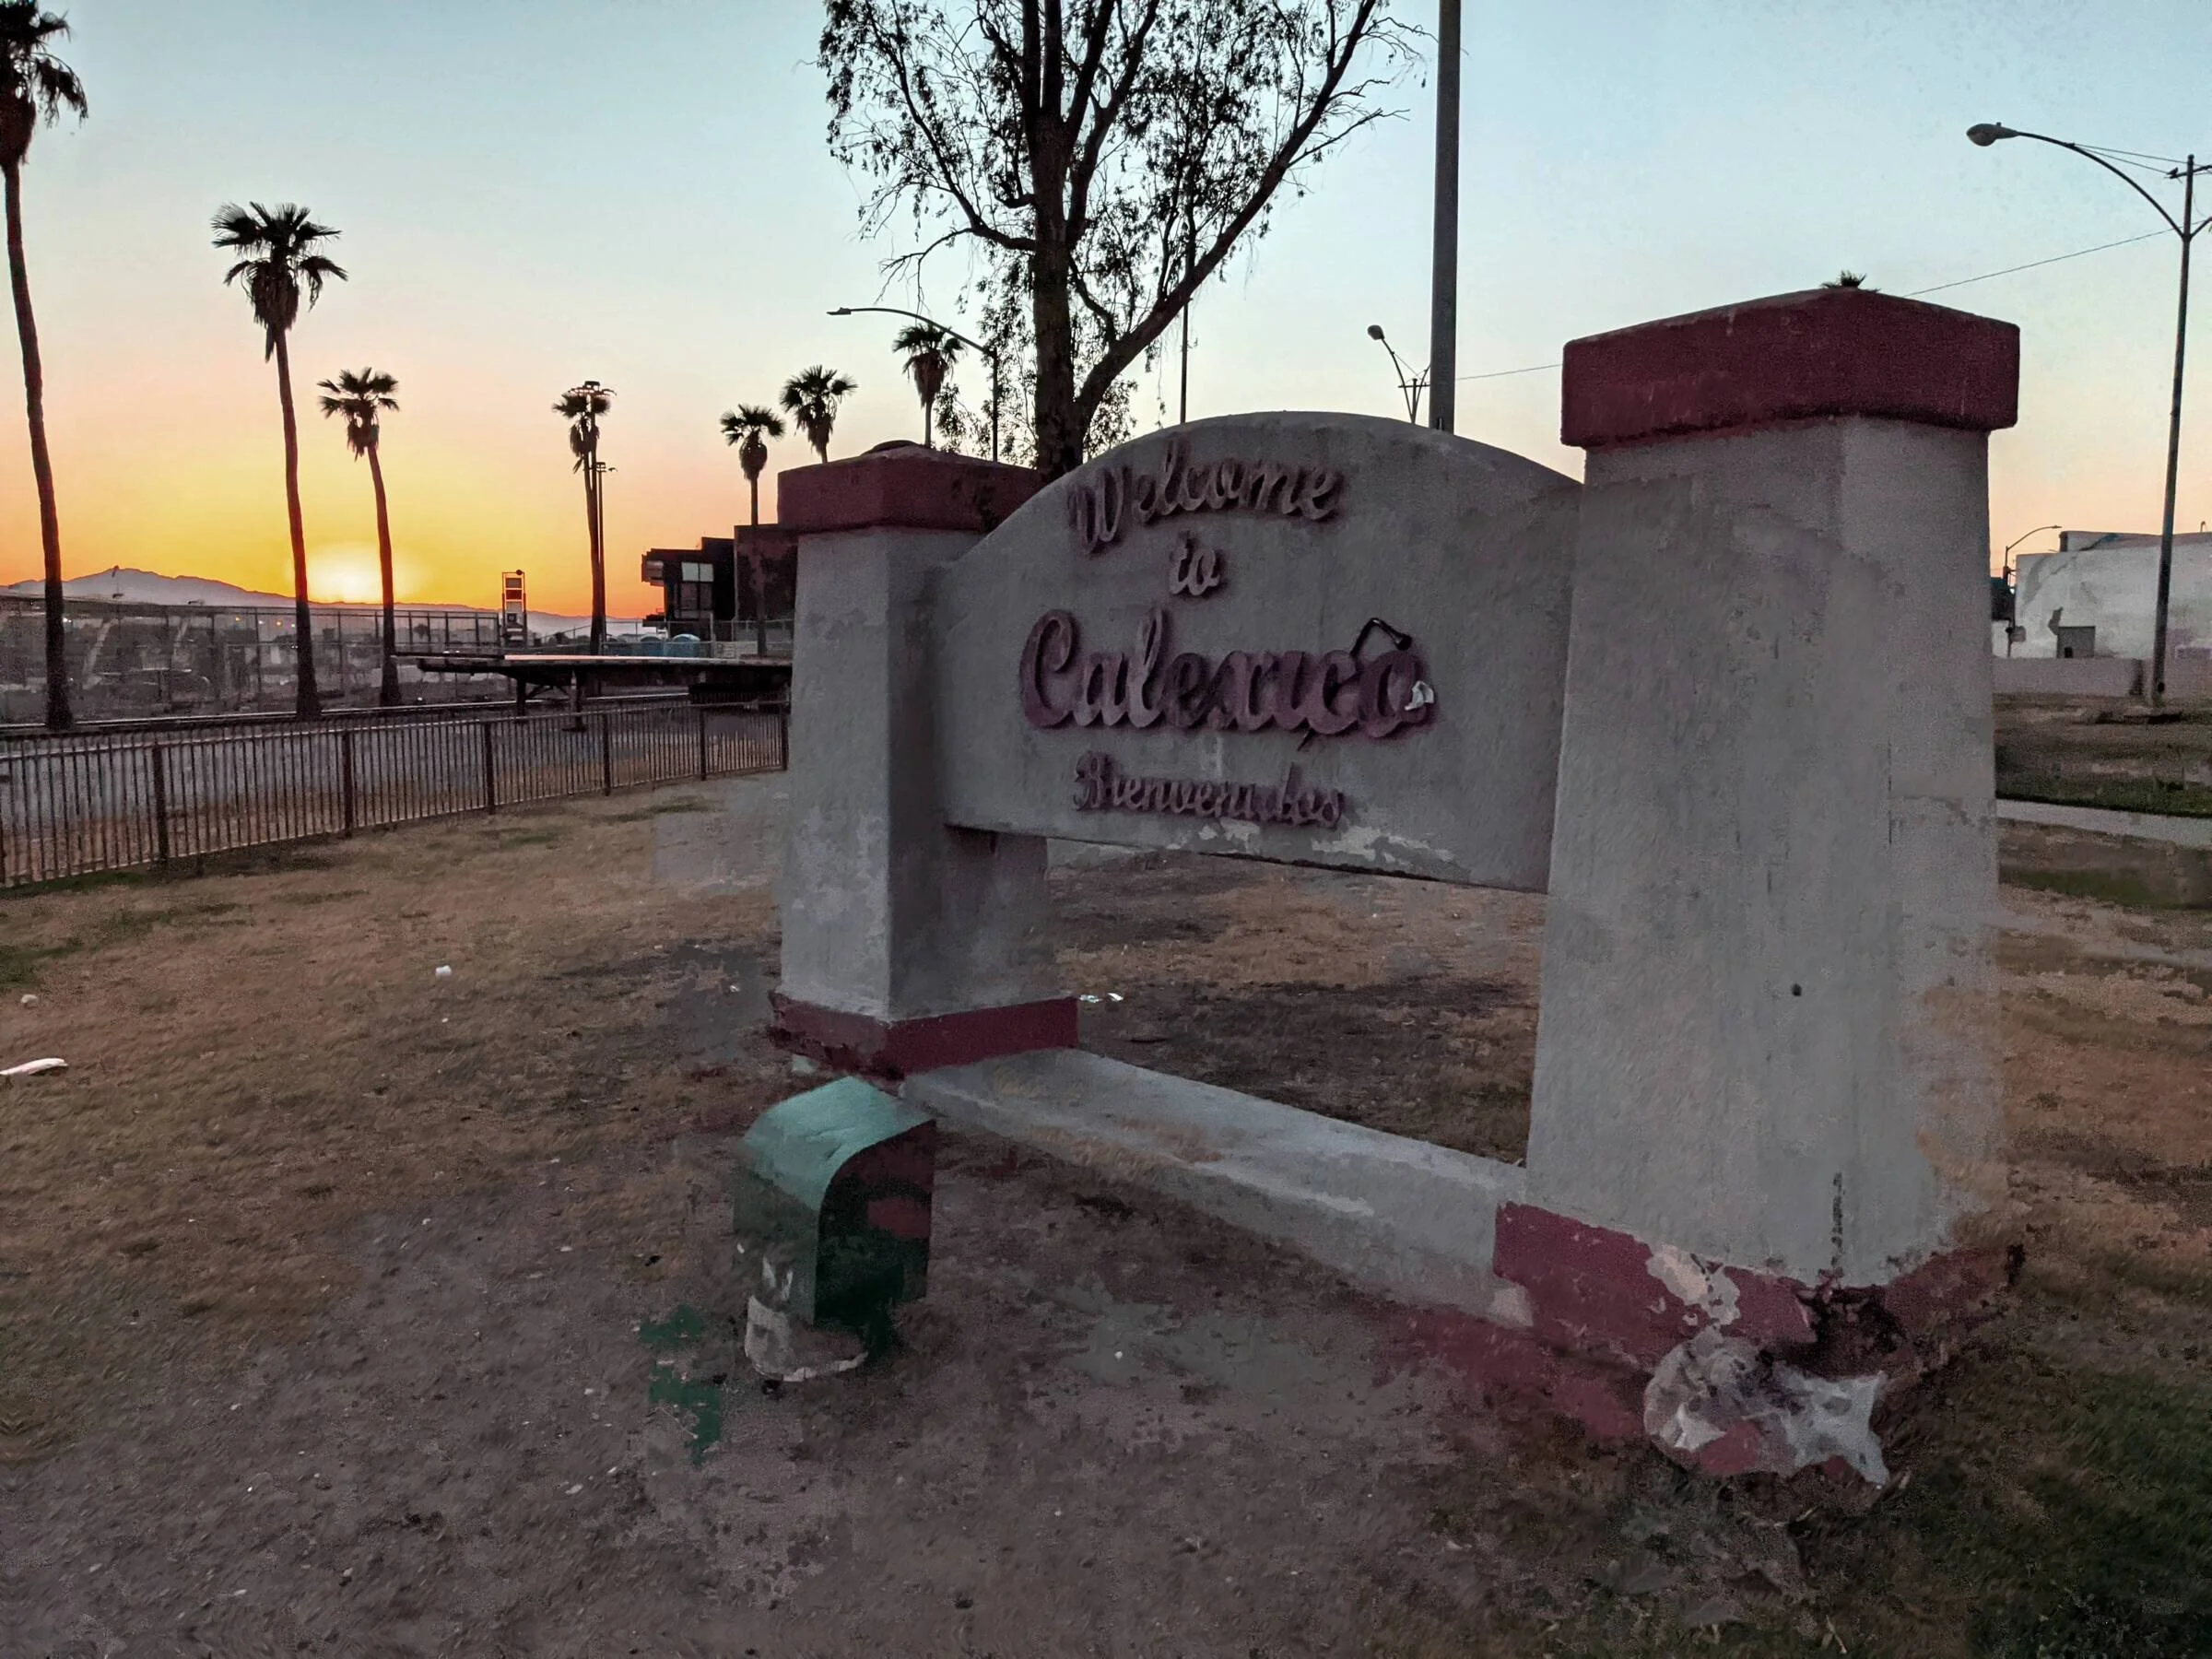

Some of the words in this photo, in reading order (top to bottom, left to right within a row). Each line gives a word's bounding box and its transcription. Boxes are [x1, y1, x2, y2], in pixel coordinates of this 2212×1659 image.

[1069, 440, 1341, 553] Welcome
[1170, 532, 1222, 596] to
[1020, 608, 1435, 738] Calexico
